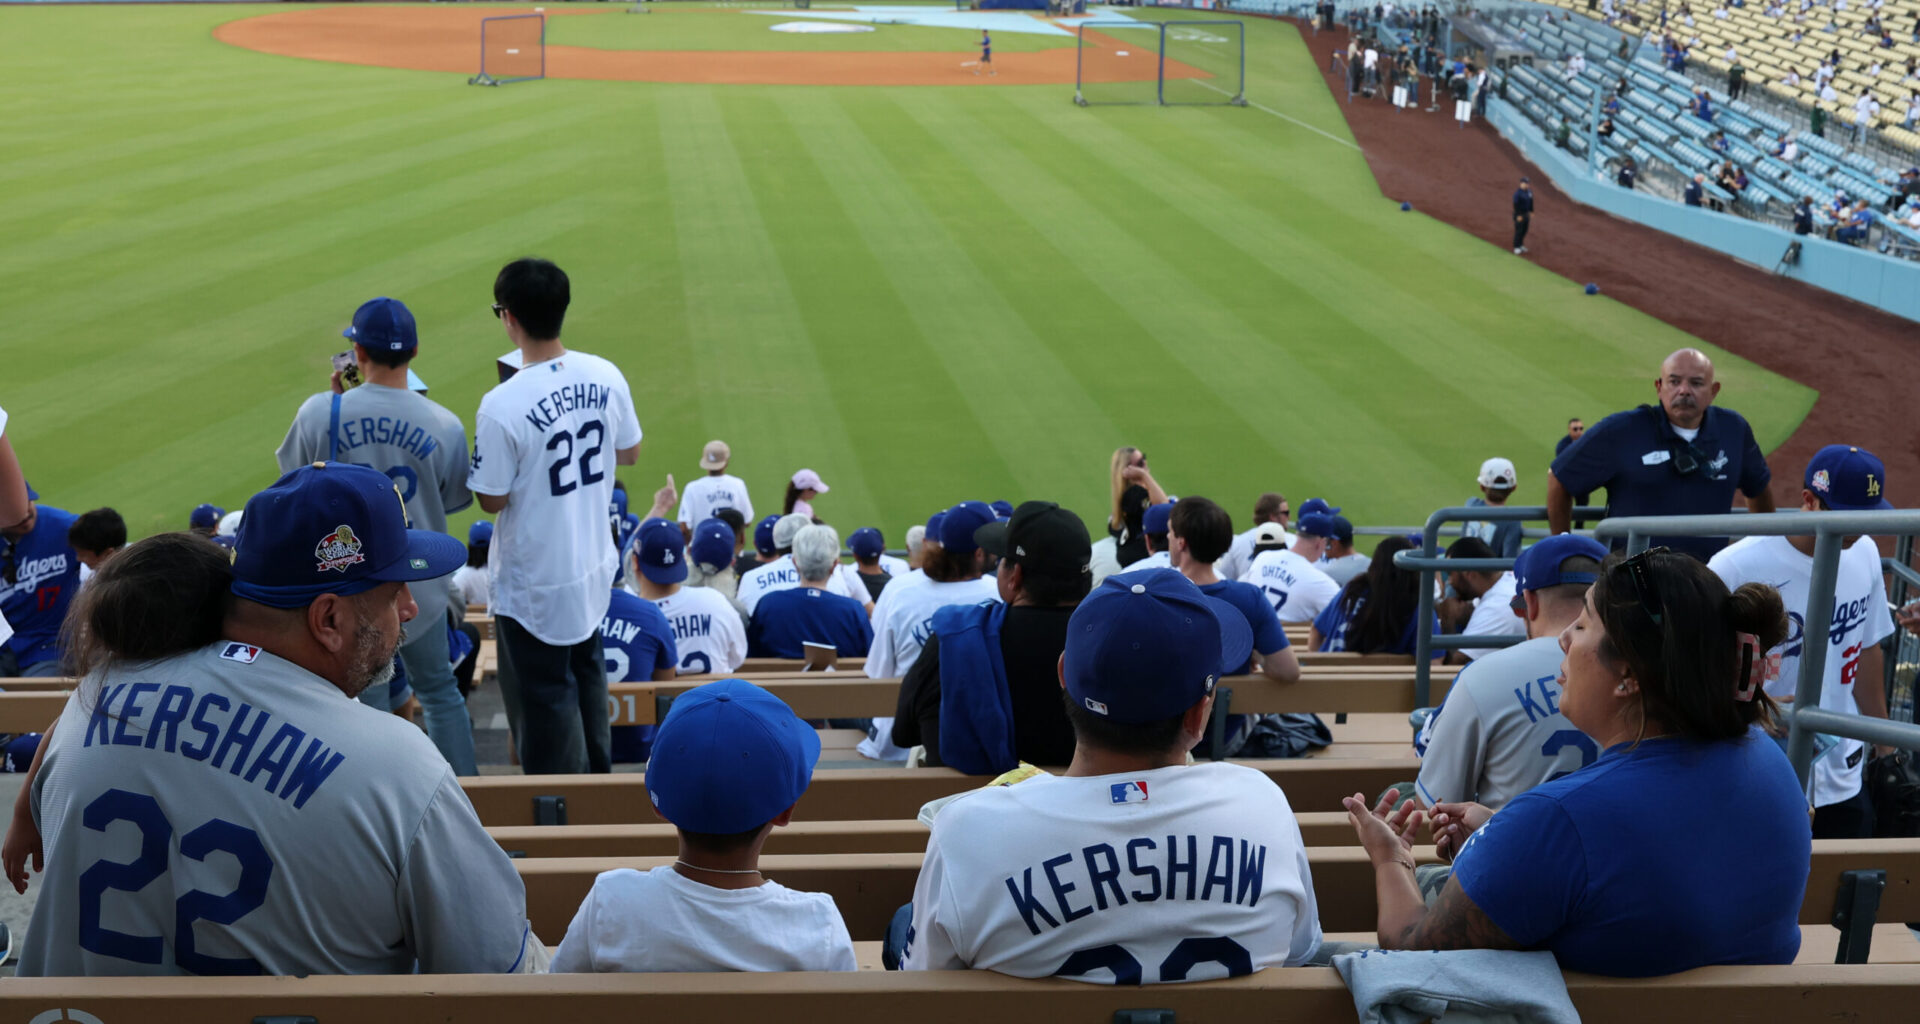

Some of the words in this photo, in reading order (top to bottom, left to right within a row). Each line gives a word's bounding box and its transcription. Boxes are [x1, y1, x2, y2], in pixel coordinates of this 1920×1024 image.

[525, 383, 611, 433] KERSHAW
[546, 420, 605, 496] 22
[1867, 474, 1881, 497] LA
[36, 585, 62, 612] 17
[756, 568, 802, 590] SANC
[1262, 565, 1297, 587] OHTANI
[83, 683, 346, 811] KERSHAW
[79, 788, 274, 977] 22
[1005, 835, 1266, 936] KERSHAW
